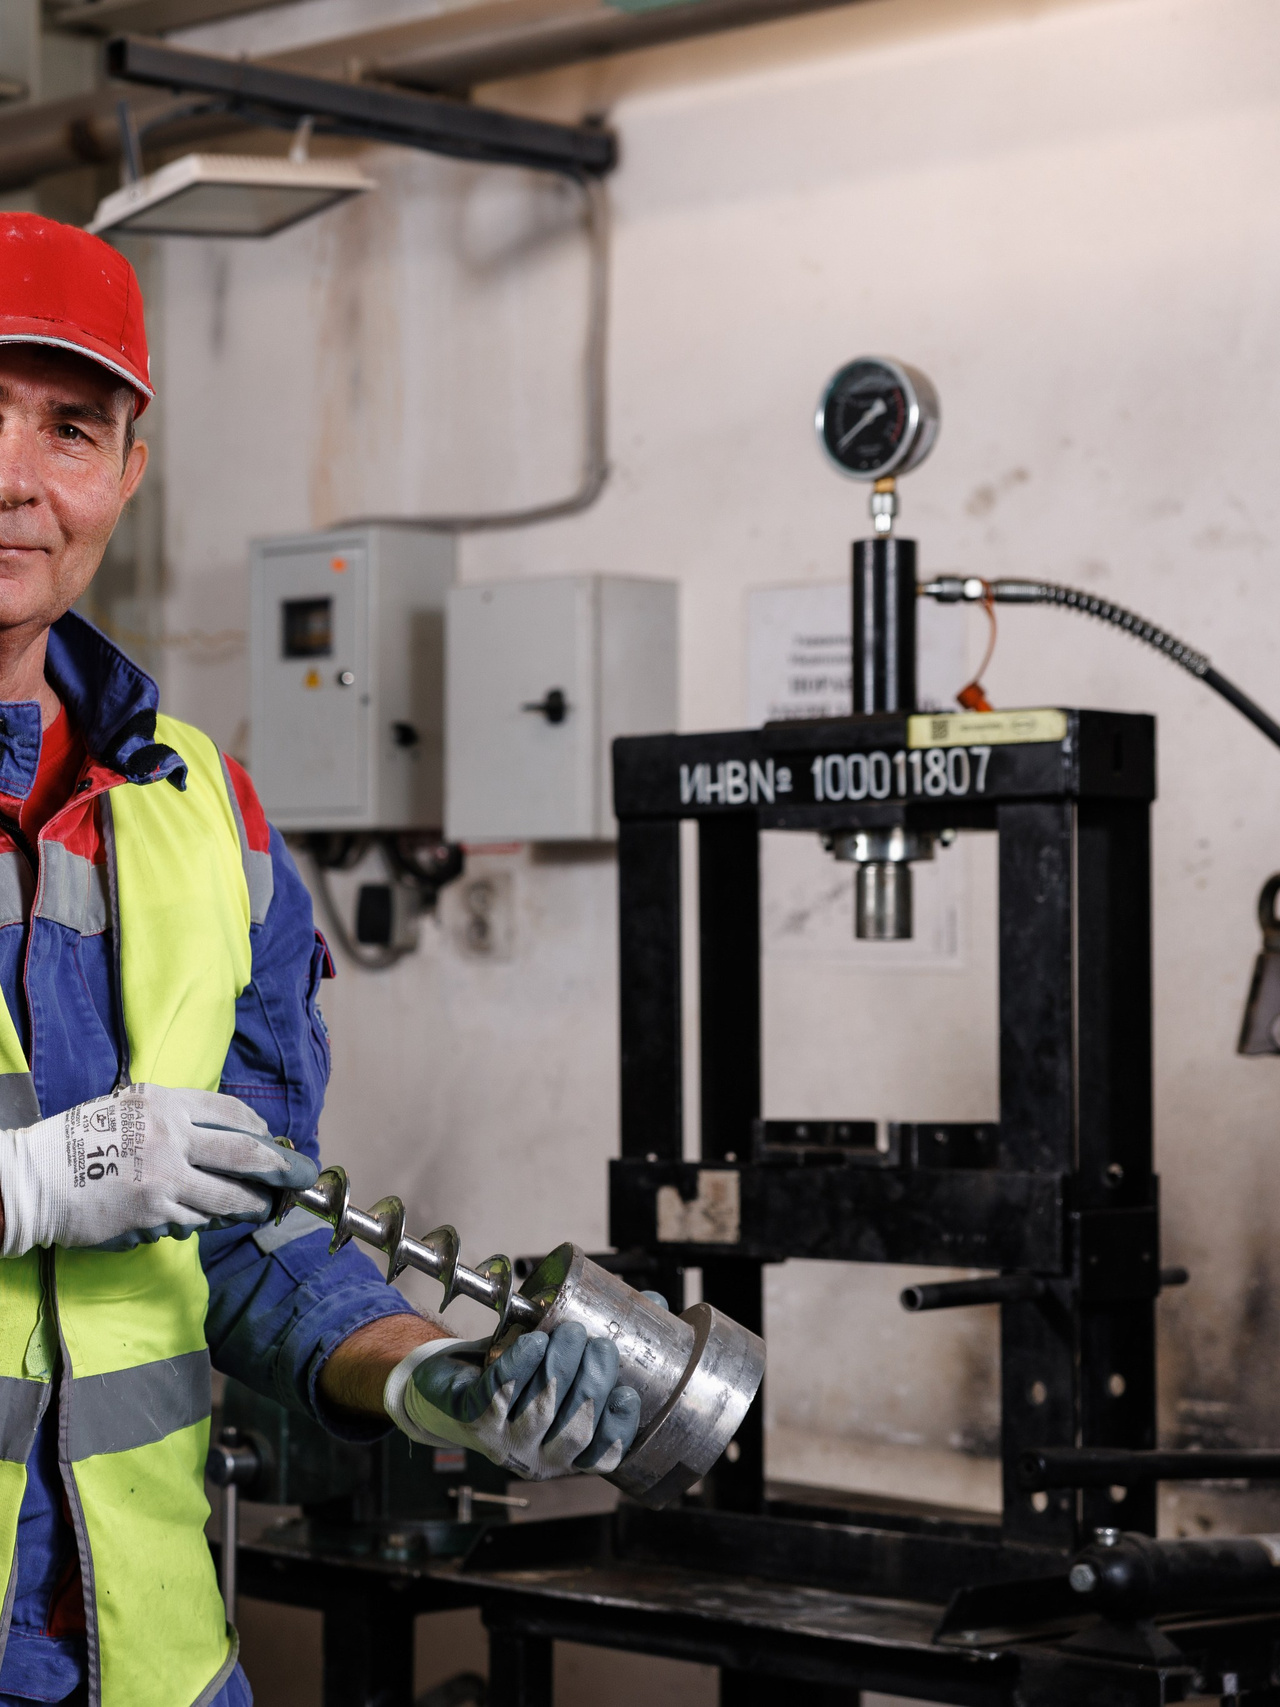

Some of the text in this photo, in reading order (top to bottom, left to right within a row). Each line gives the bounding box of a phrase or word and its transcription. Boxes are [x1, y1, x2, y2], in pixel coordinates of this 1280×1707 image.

[811, 746, 991, 801] 100011807
[109, 1105, 115, 1116] EN
[77, 1138, 86, 1171] 12/2022
[133, 1100, 146, 1182] BABBLER
[87, 1146, 105, 1180] 10
